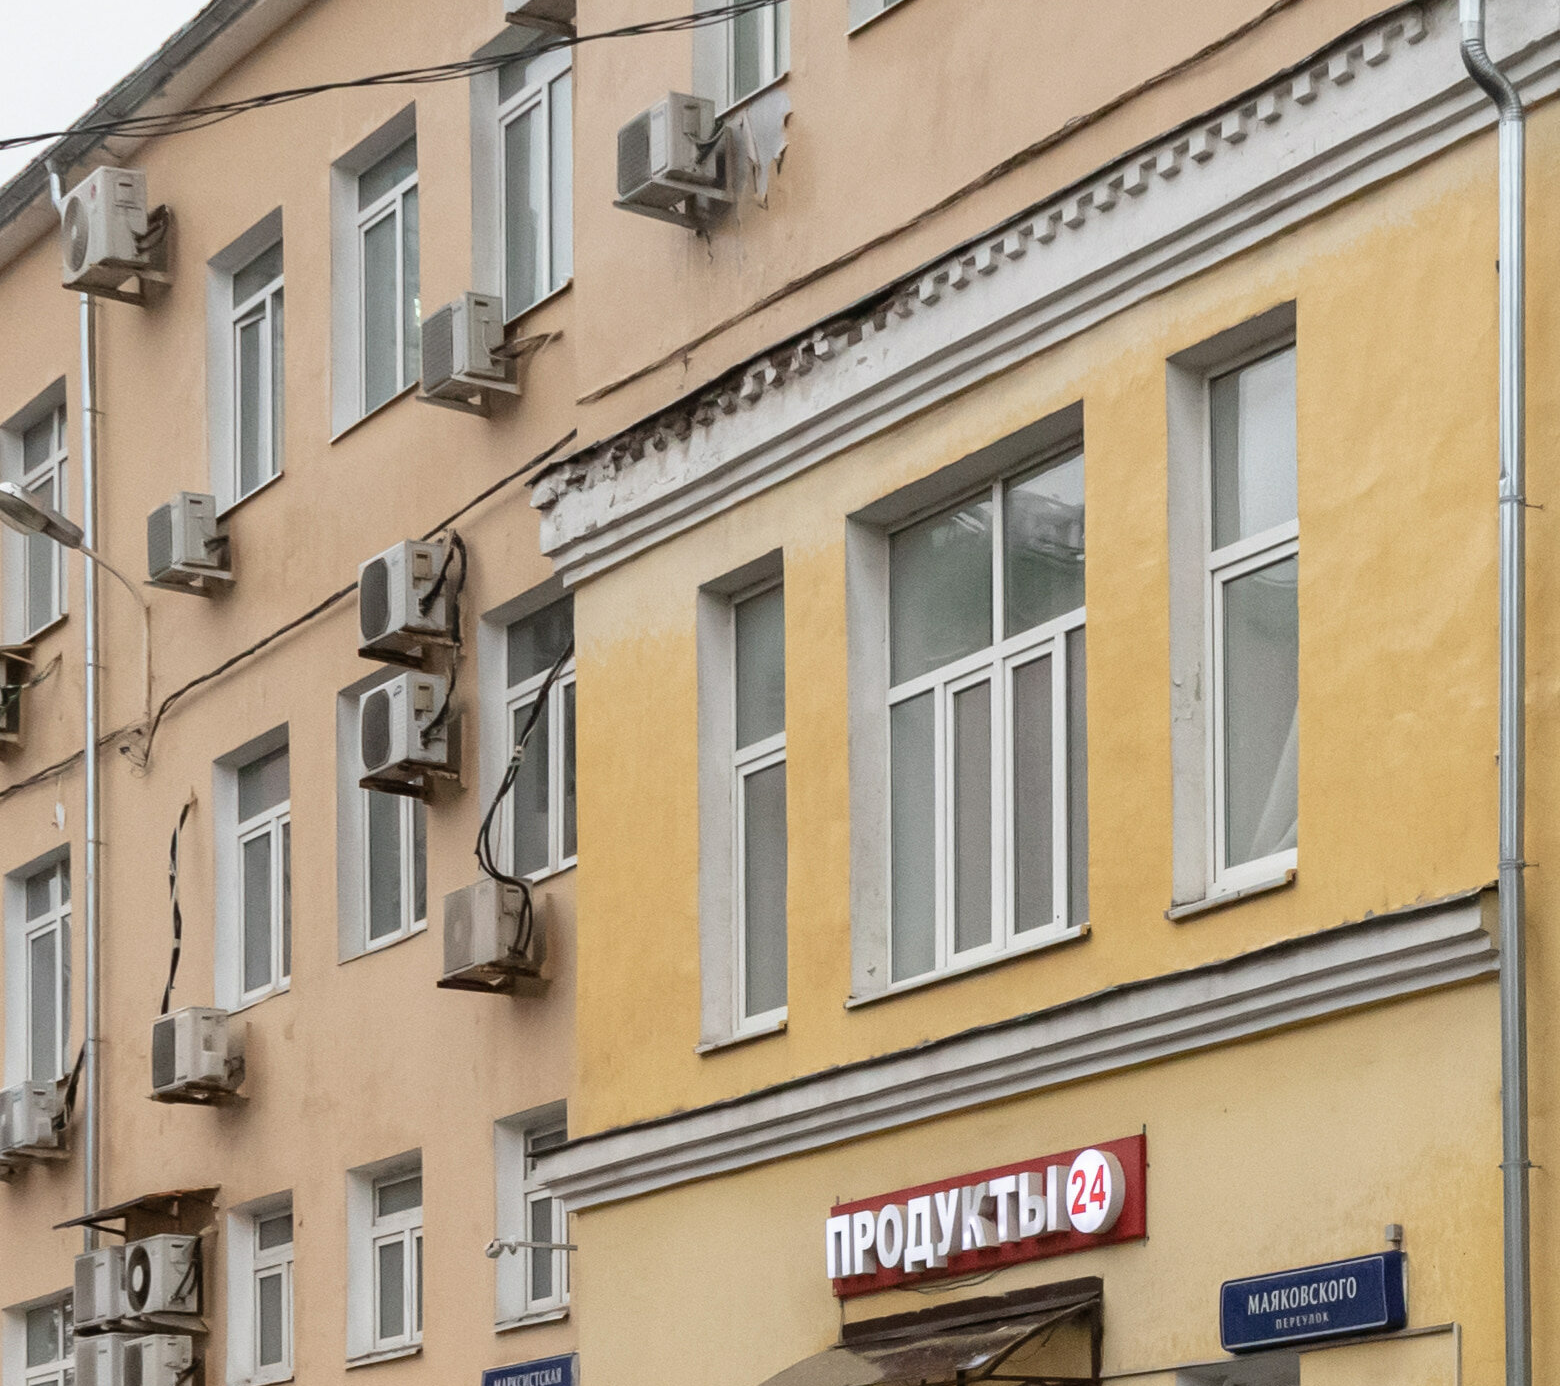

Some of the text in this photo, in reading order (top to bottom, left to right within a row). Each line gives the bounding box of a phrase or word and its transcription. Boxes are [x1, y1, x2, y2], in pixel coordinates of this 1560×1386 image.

[826, 1164, 1107, 1279] ПРОДУКТЫ 24
[1247, 1276, 1357, 1315] МАЯКОВСКОГО
[1275, 1311, 1330, 1330] ПЕРЕУЛОК
